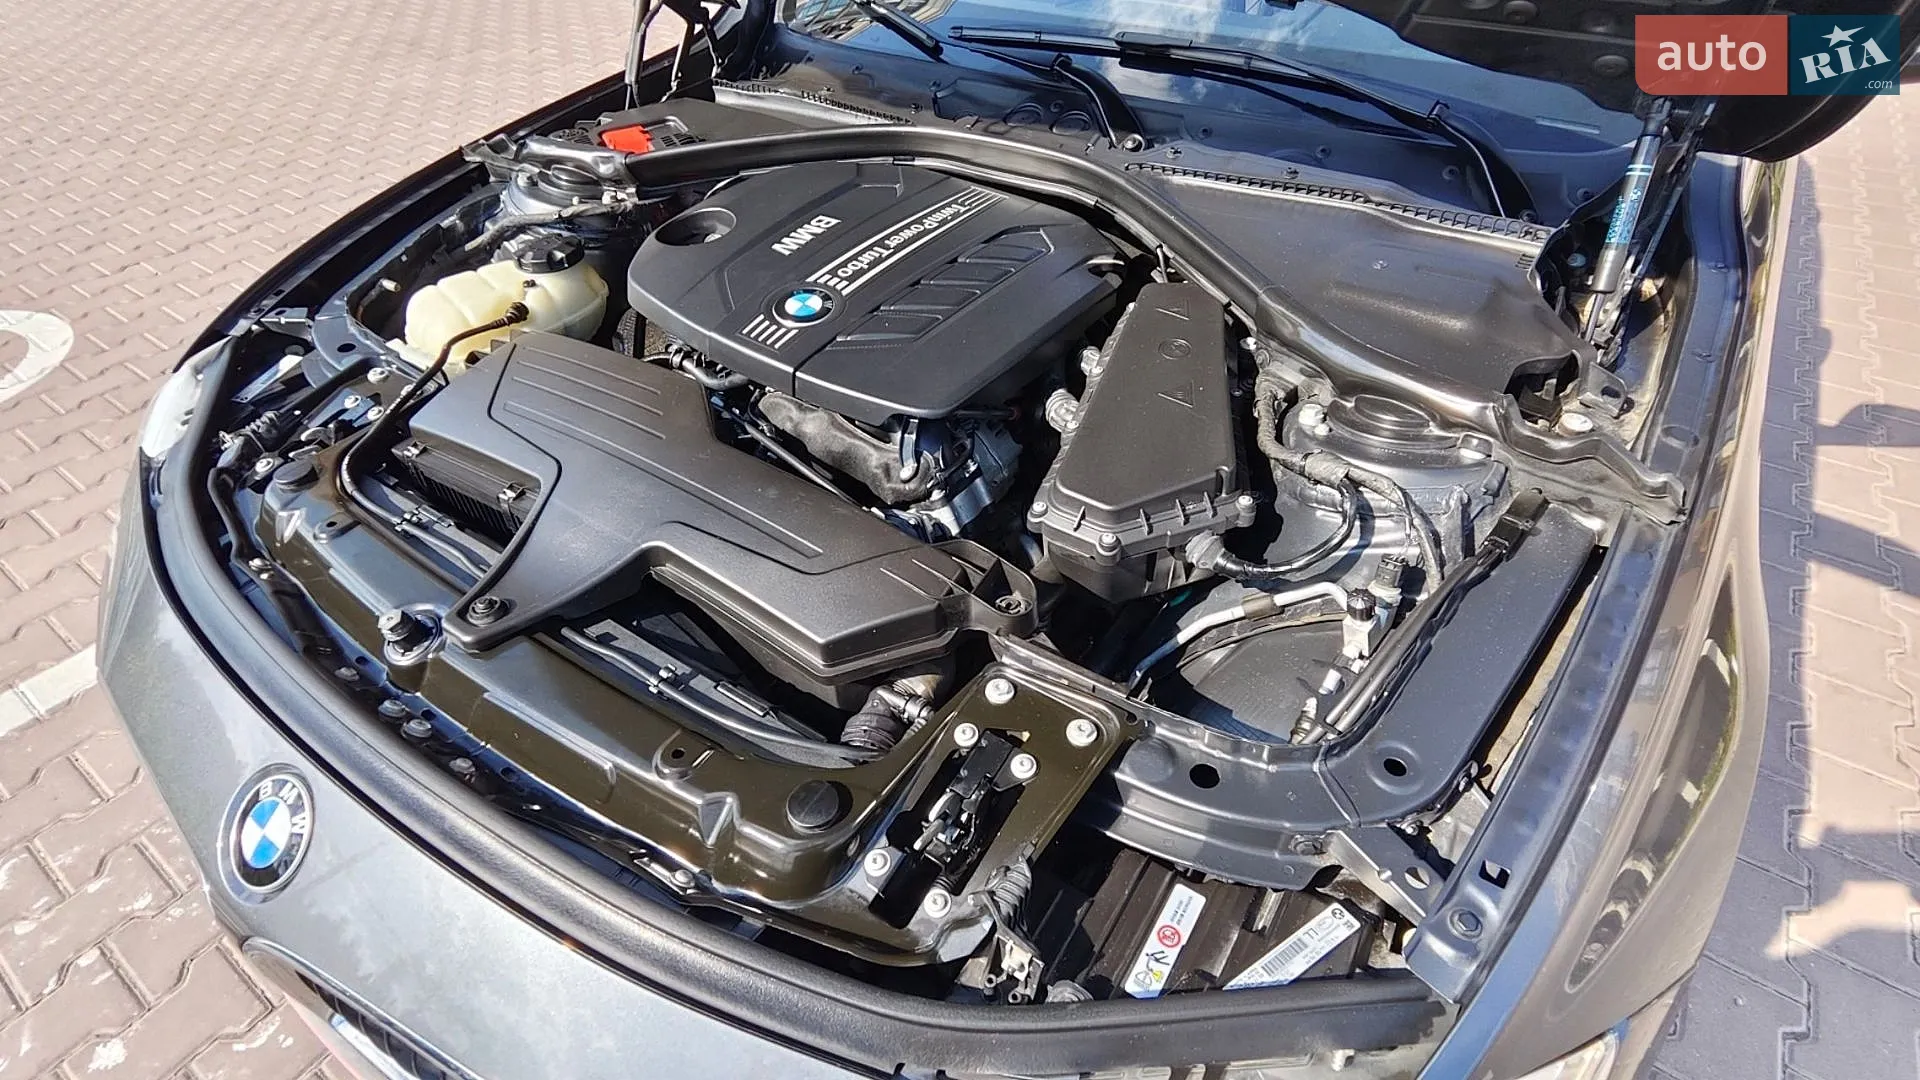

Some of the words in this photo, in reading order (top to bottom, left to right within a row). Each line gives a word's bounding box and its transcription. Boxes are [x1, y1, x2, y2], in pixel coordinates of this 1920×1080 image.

[771, 214, 842, 256] BMW
[883, 200, 970, 250] TwinPower
[837, 246, 895, 278] Turbo
[258, 781, 308, 834] BMW
